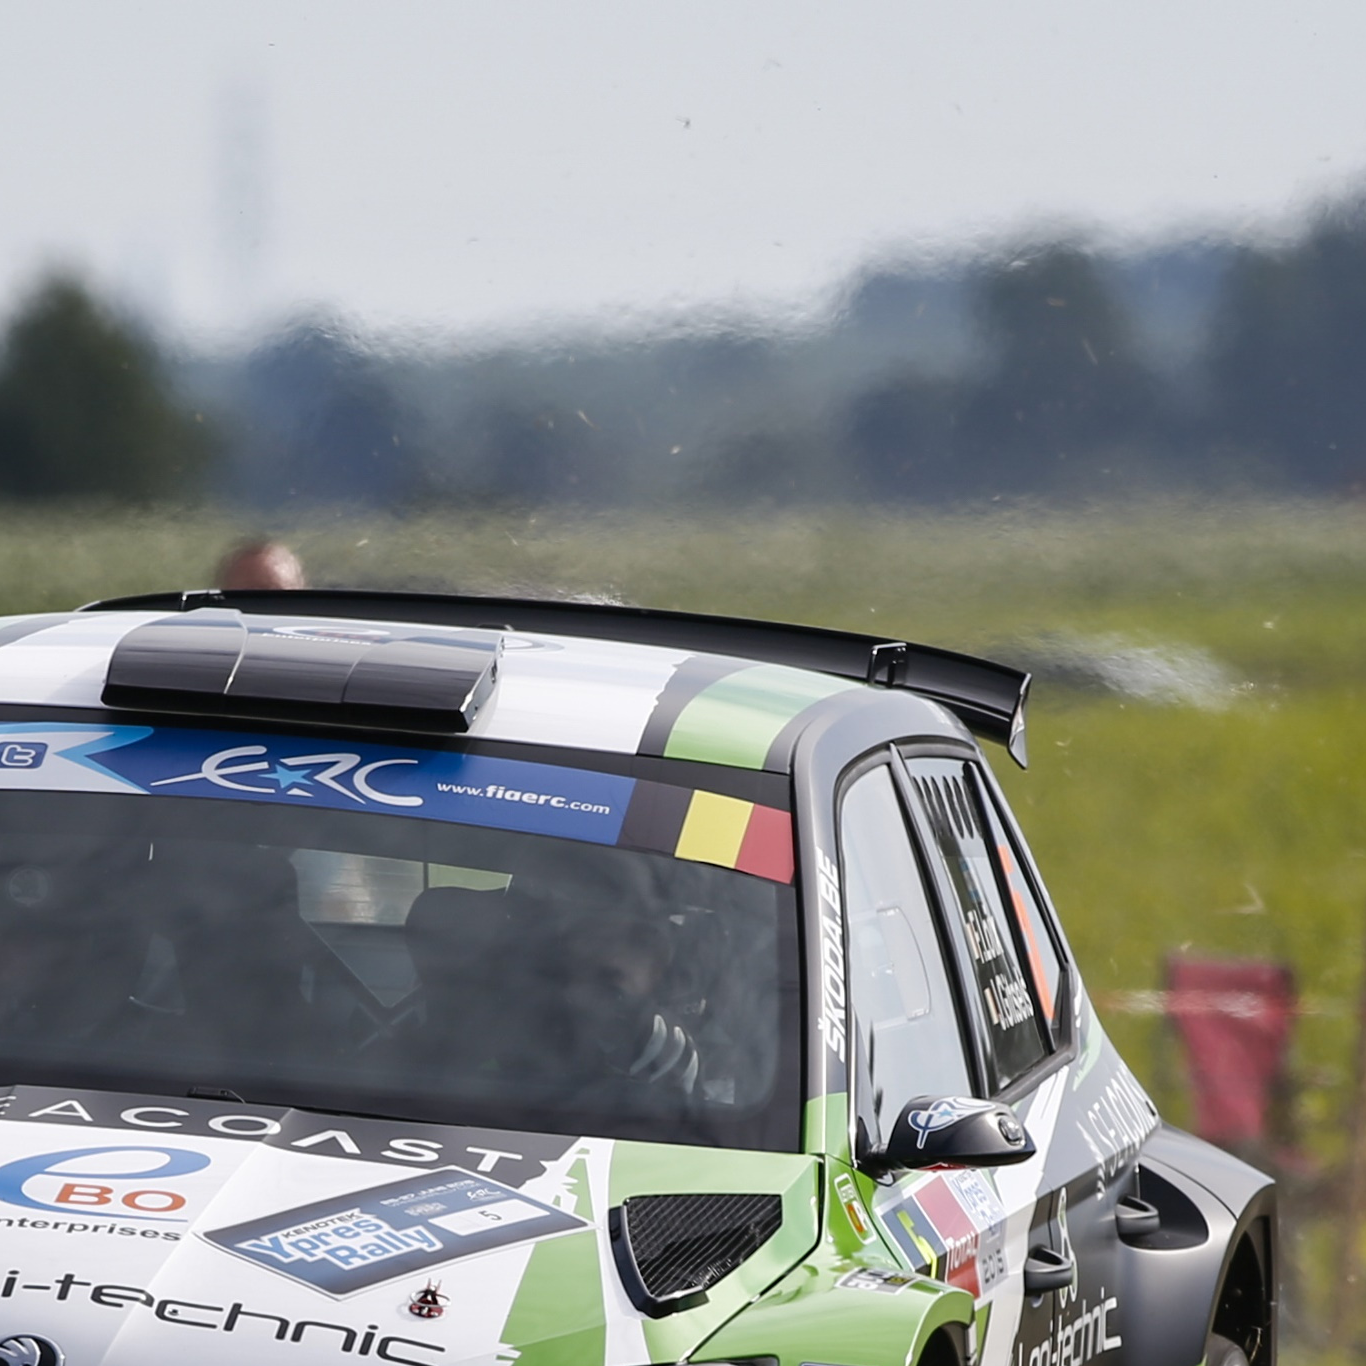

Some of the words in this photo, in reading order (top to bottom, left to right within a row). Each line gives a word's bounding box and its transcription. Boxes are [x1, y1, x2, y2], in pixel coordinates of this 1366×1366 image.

[151, 745, 423, 807] ERC
[437, 783, 610, 815] www.fiaerc.com
[54, 1182, 186, 1213] BO
[281, 1211, 360, 1238] KENOTEK
[478, 1210, 502, 1221] 5
[249, 1218, 384, 1259] Ypres
[334, 1227, 436, 1266] Rally
